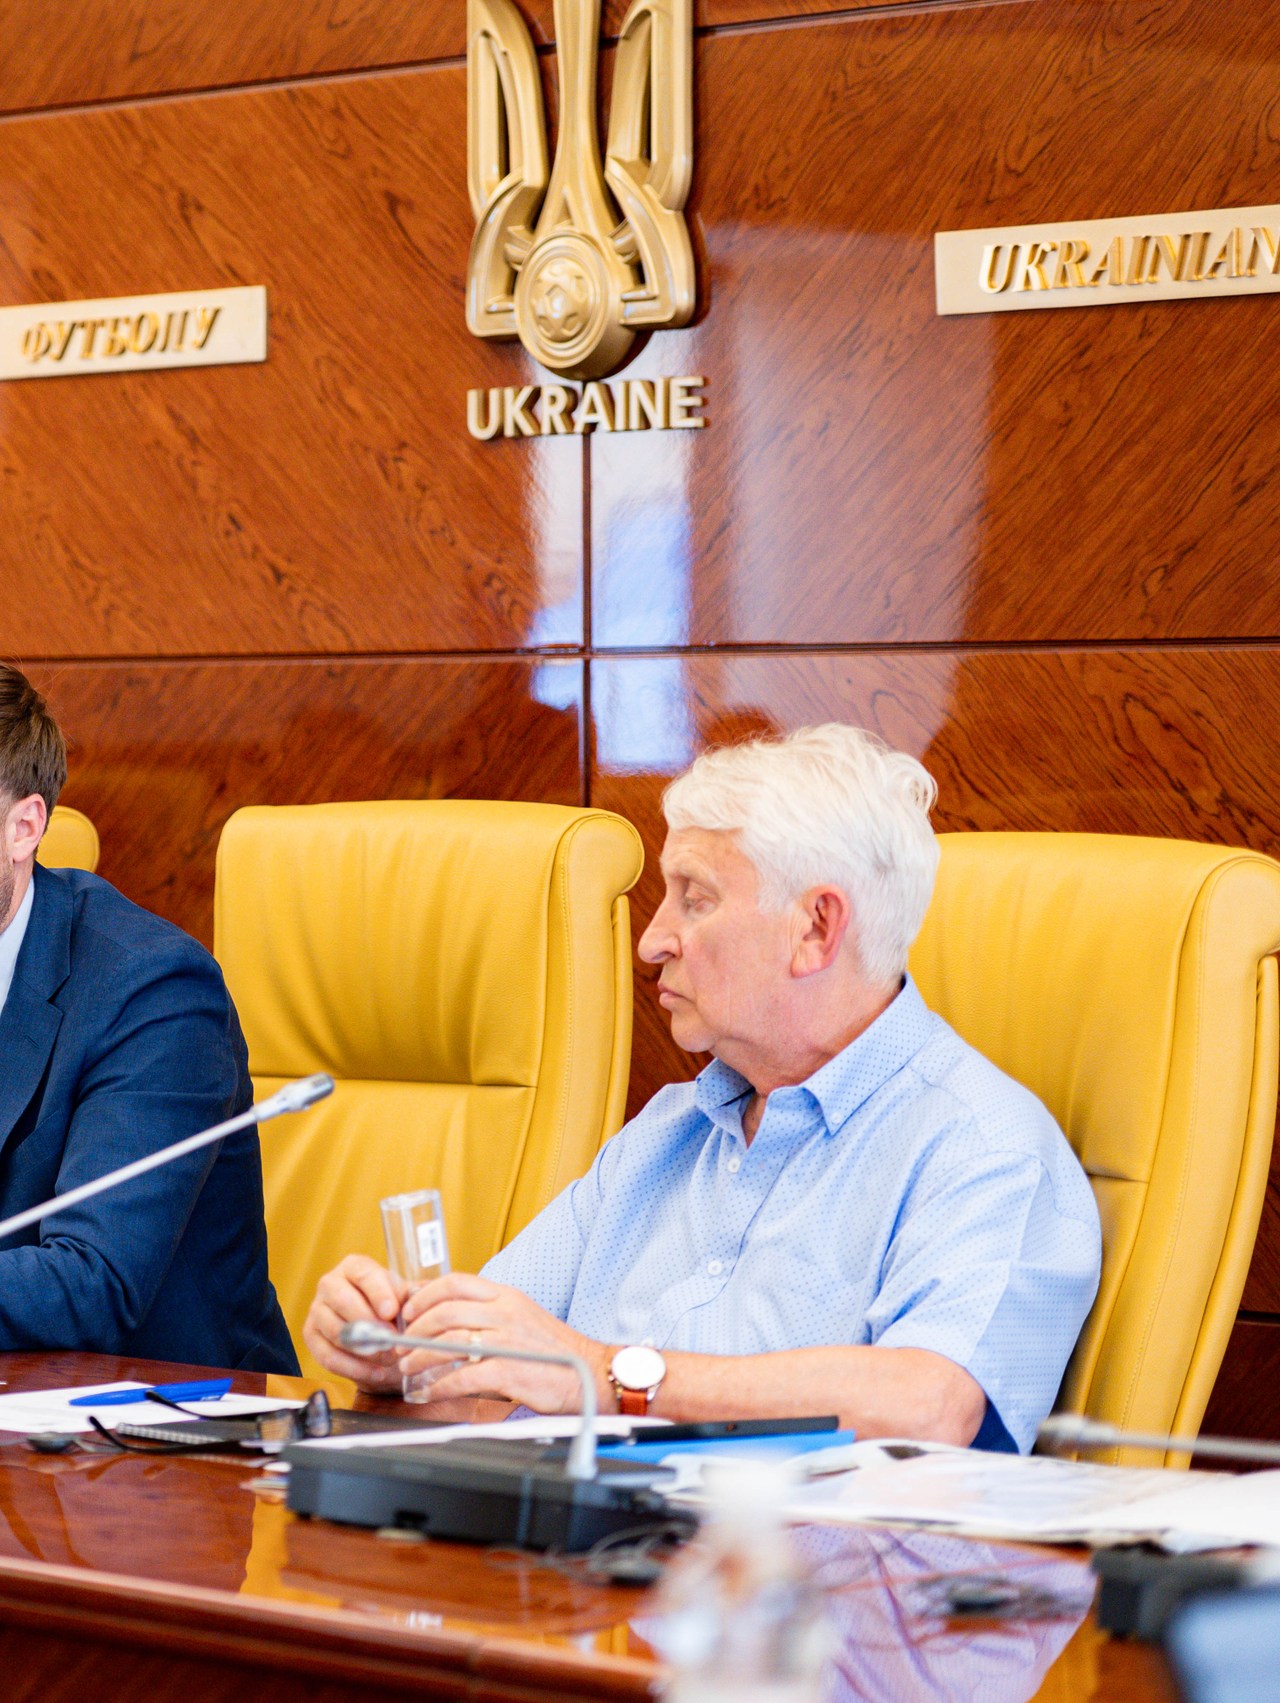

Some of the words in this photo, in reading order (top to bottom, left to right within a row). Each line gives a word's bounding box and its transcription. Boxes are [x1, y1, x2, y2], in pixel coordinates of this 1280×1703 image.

[978, 227, 1280, 293] UKRAINIAN
[22, 306, 223, 363] ФУТБОЛУ
[466, 375, 709, 440] UKRAINE
